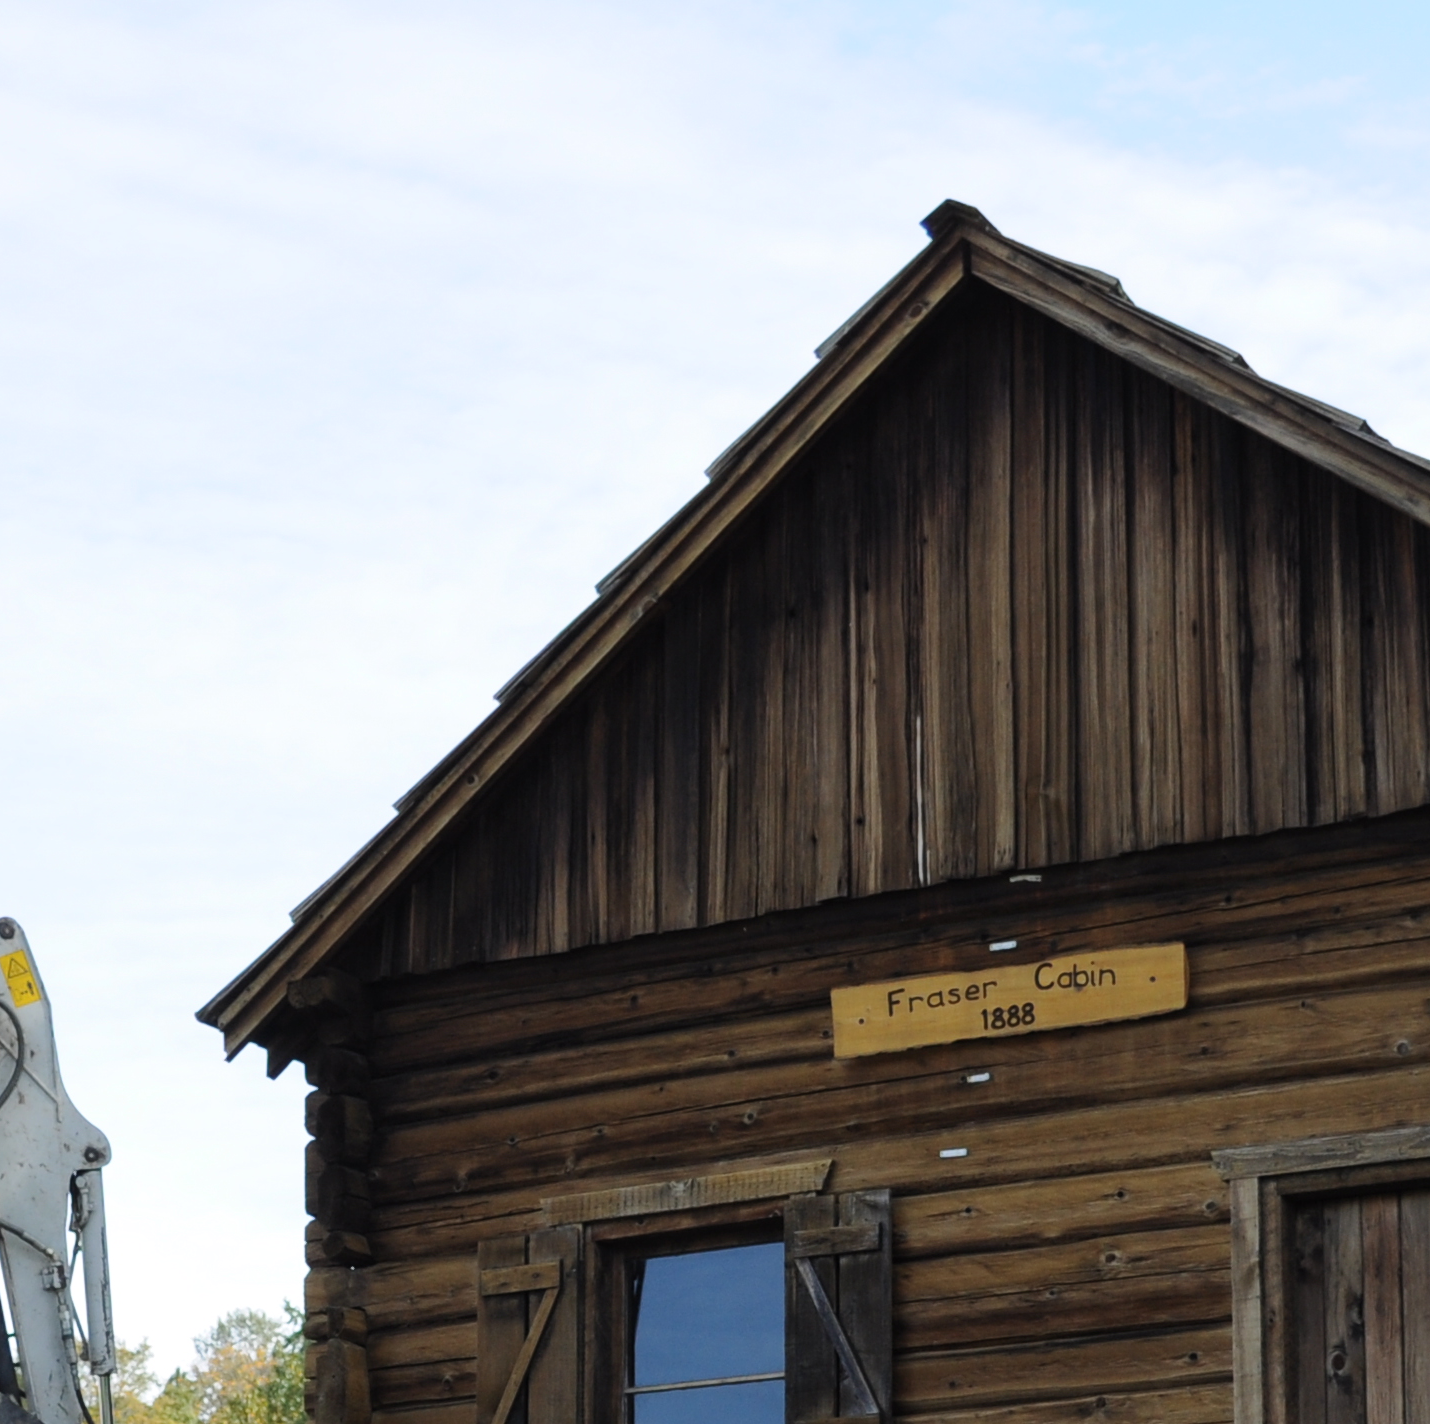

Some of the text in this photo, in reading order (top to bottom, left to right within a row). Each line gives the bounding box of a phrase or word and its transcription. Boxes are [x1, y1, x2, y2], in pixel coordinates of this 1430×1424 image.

[887, 961, 1117, 1017] Fraser Cabin
[981, 1002, 1036, 1031] 1888
